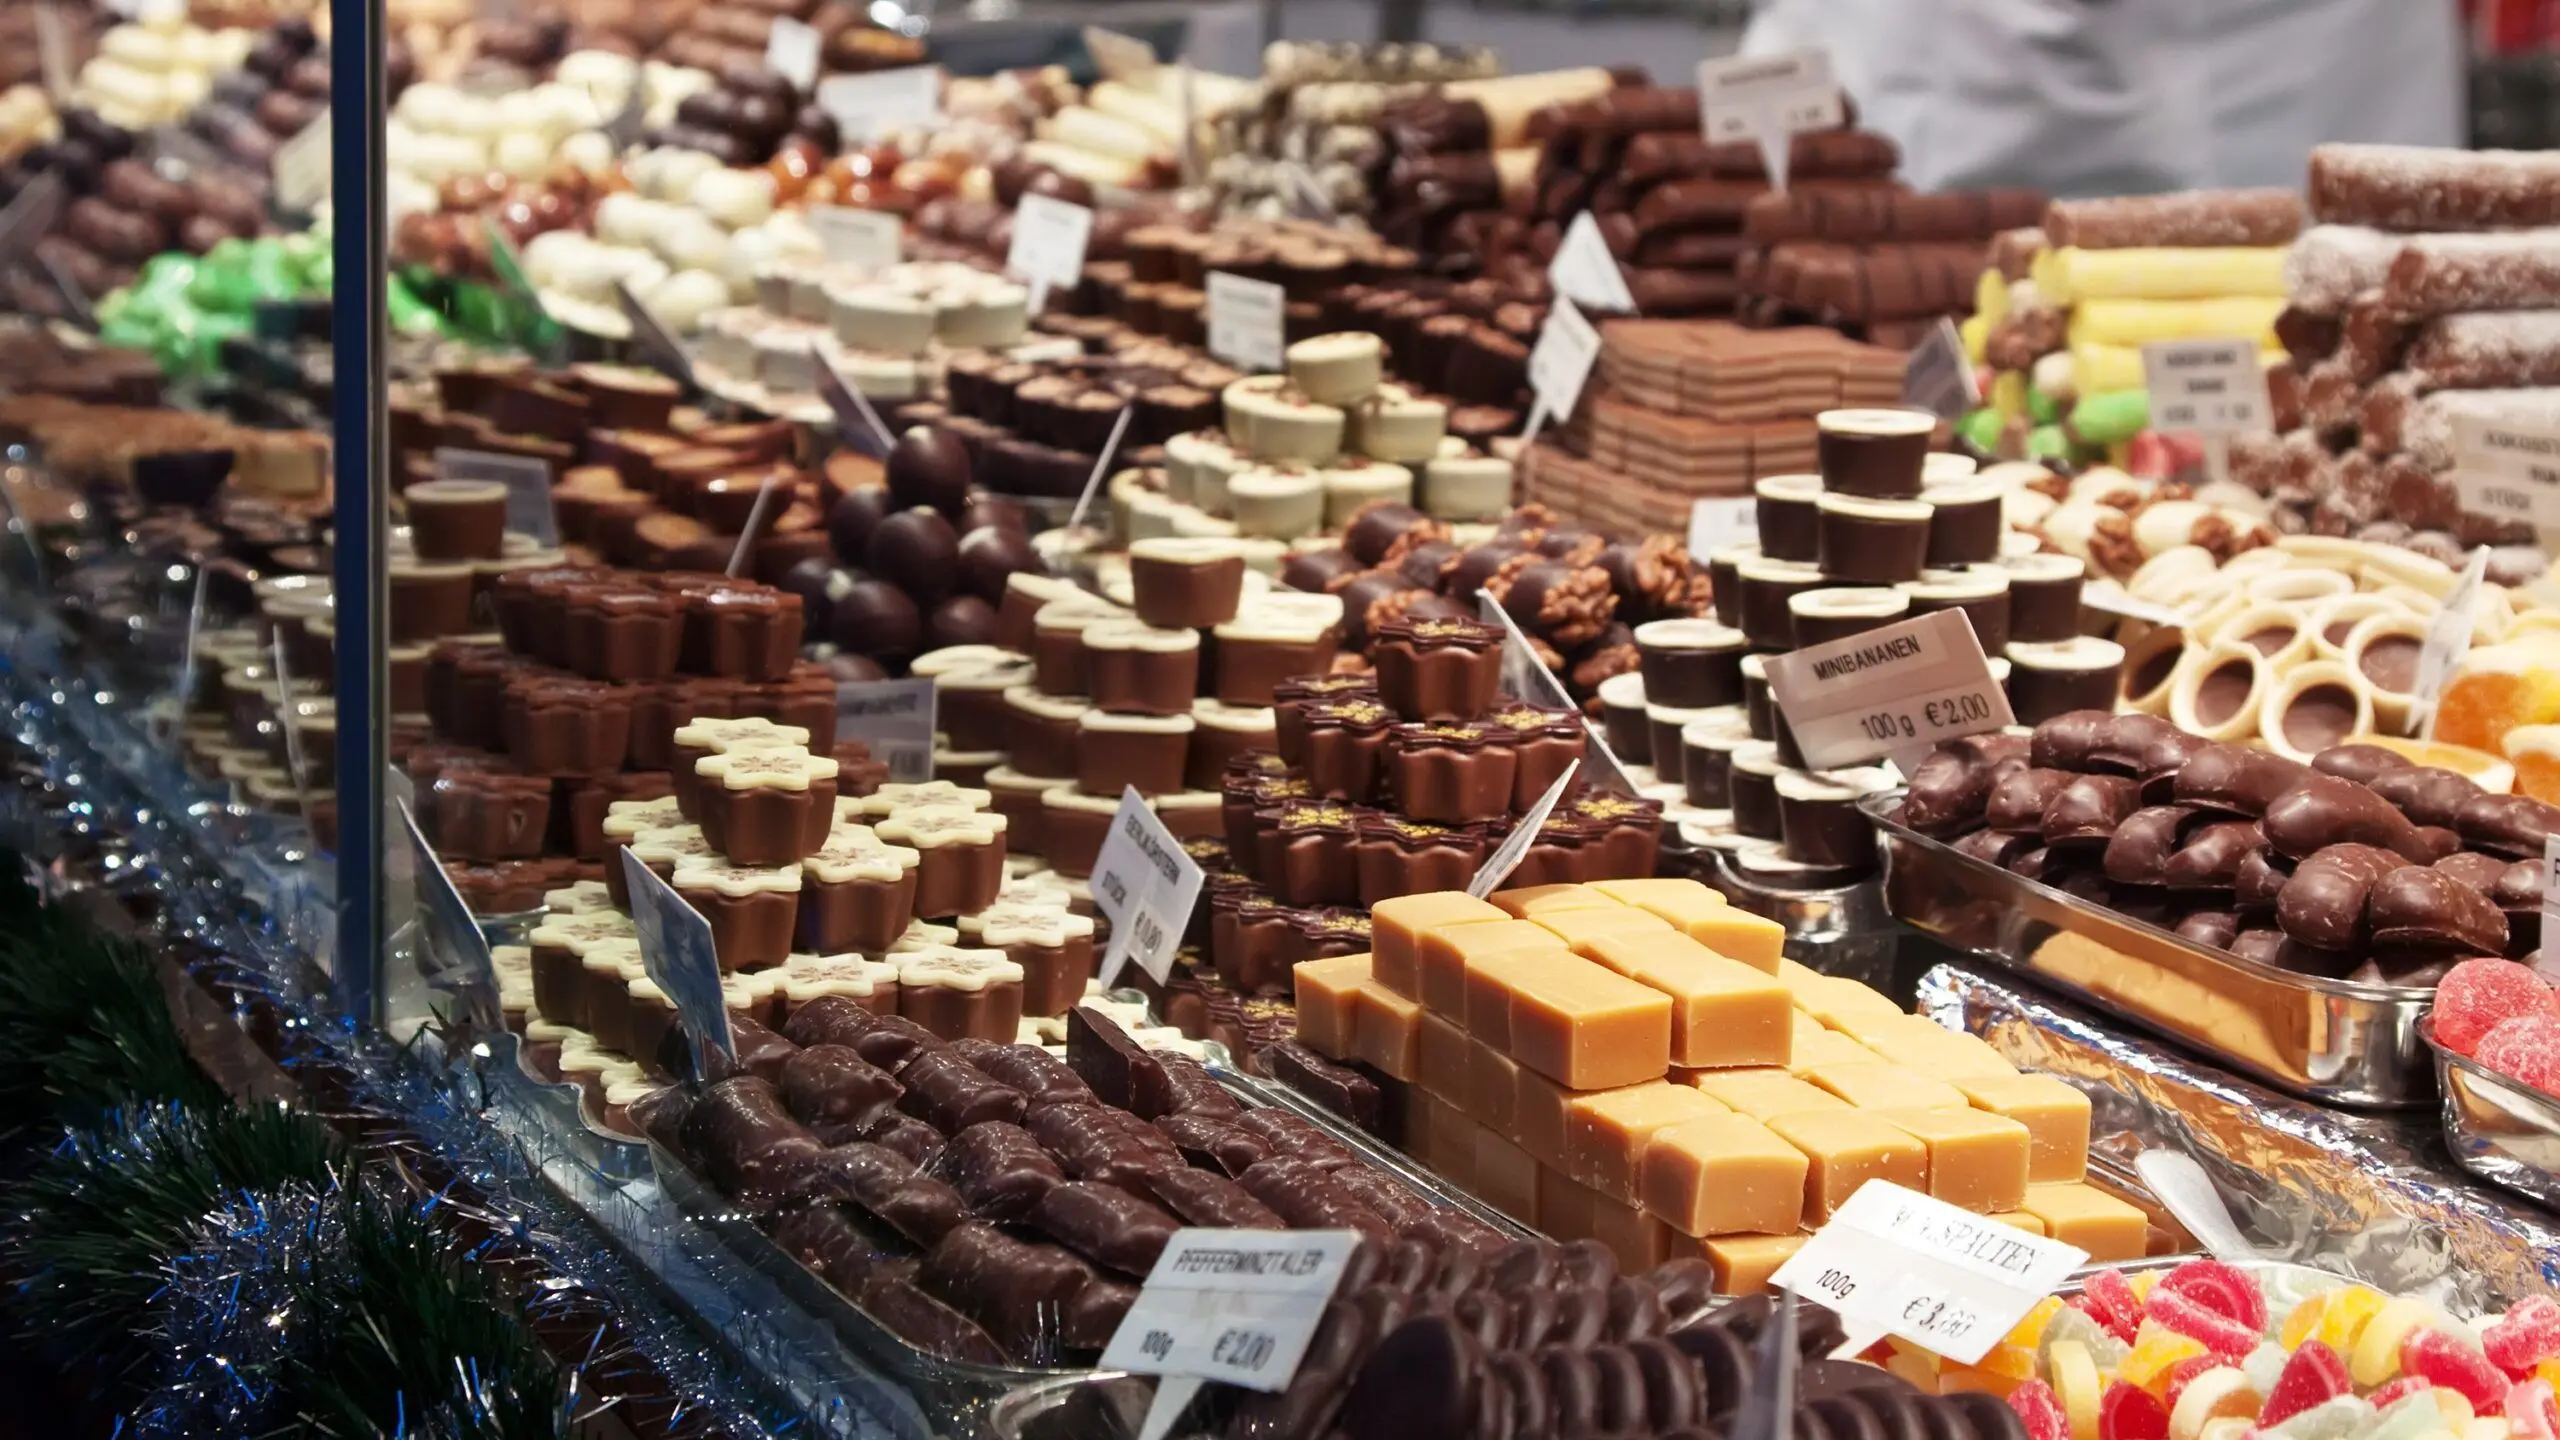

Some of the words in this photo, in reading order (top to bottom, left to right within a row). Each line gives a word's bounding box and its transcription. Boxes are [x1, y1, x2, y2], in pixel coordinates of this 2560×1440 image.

[1812, 634, 1921, 681] MINIBANANEN
[1861, 713, 1898, 741] 100
[1900, 715, 1916, 737] g
[1925, 693, 1991, 727] €2,00
[1172, 1248, 1325, 1276] PFEFFERMINZTALER
[1815, 1268, 1856, 1300] 100g
[1138, 1329, 1175, 1362] 100g
[1212, 1328, 1276, 1372] €2,00
